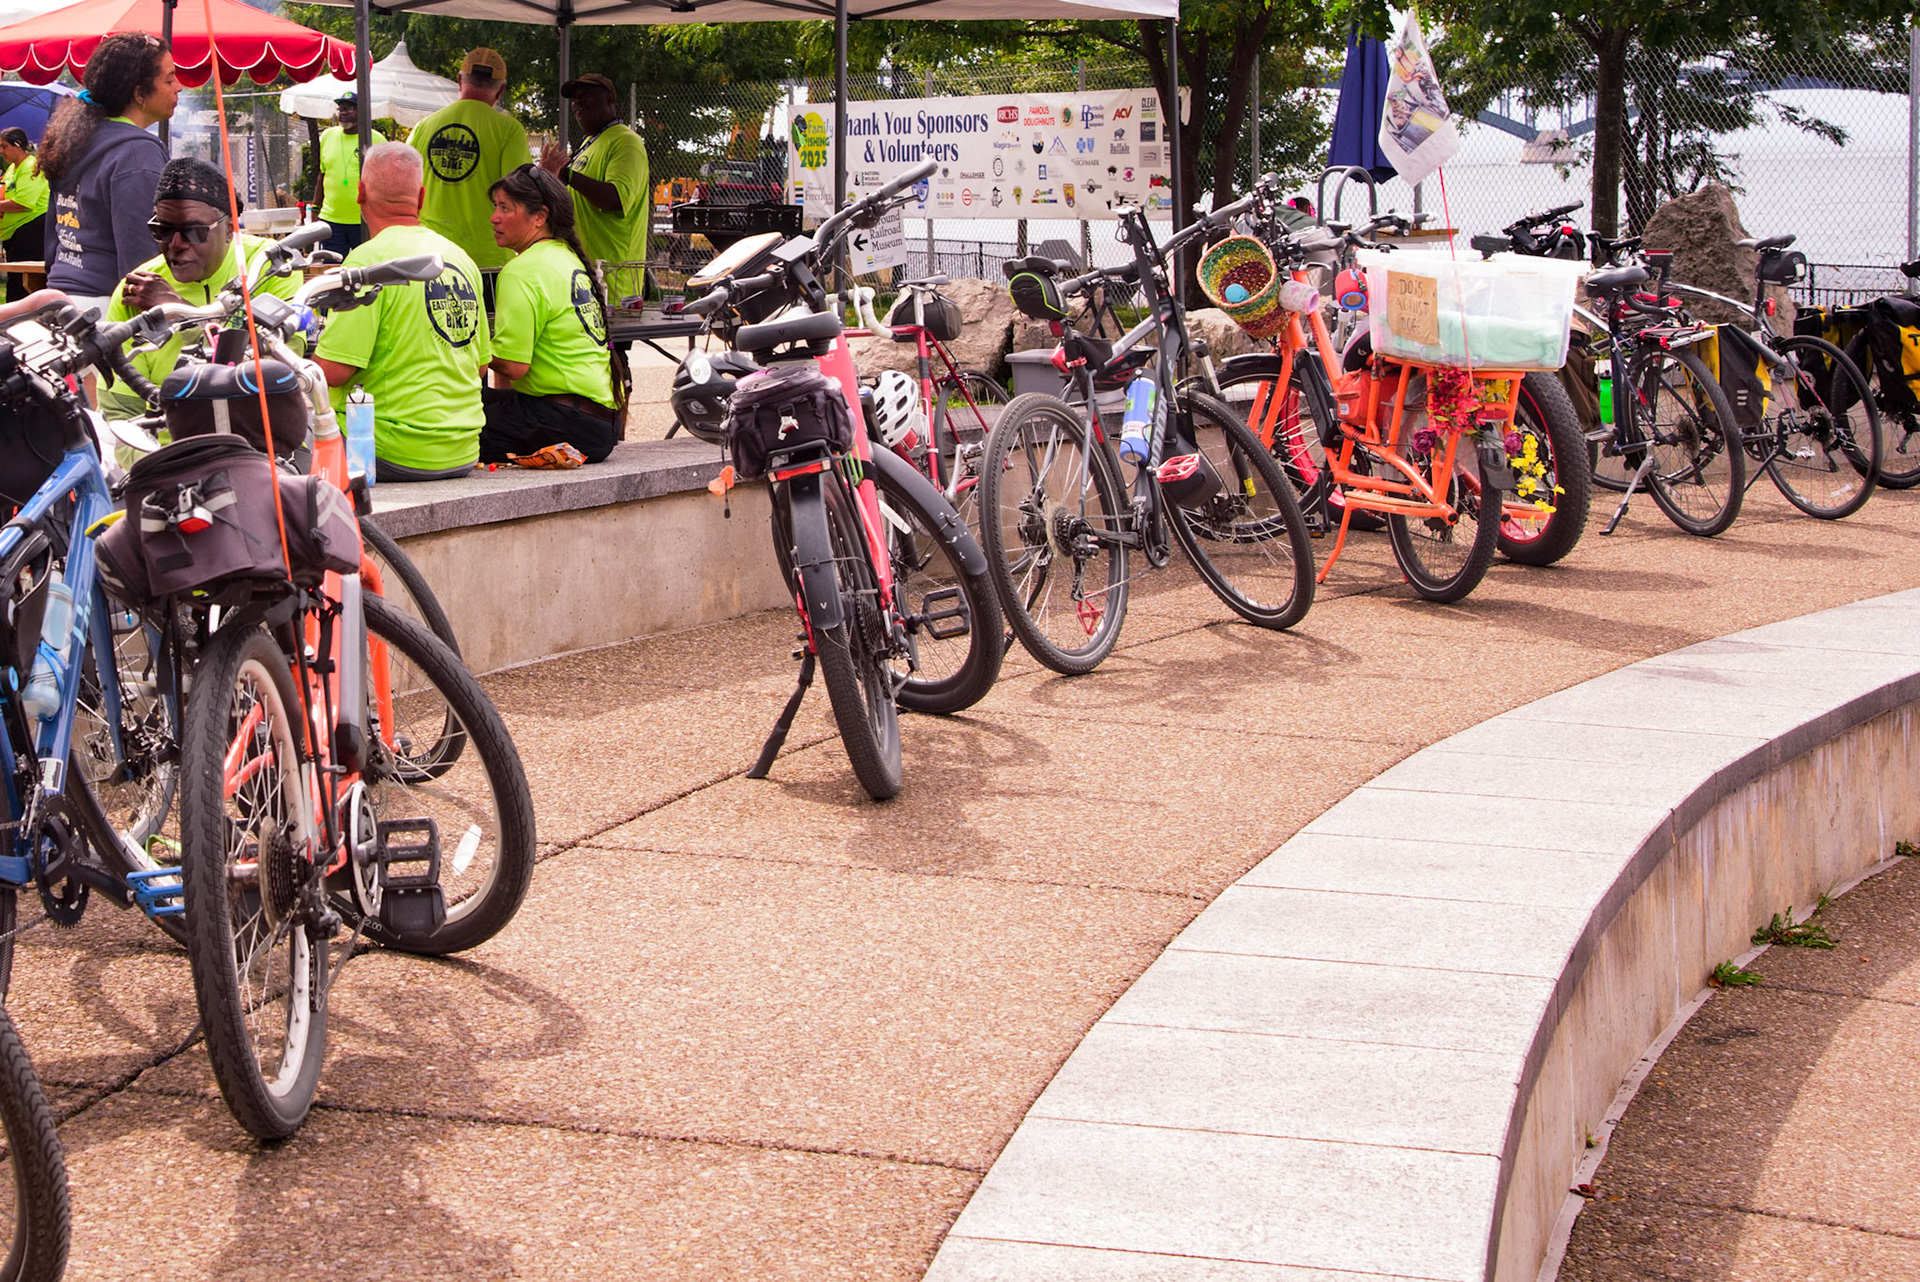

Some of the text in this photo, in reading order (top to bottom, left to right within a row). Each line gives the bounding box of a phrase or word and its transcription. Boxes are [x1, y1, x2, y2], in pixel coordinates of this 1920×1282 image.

[1029, 106, 1049, 115] FAMOUS
[846, 110, 989, 139] hank You Sponsors
[1023, 116, 1055, 127] DOUGHNUTS
[800, 149, 828, 168] 2025
[864, 138, 959, 163] & Volunteers
[878, 210, 901, 225] ound
[869, 222, 902, 240] Railroad
[872, 238, 903, 252] Museum
[446, 312, 469, 328] BIKE
